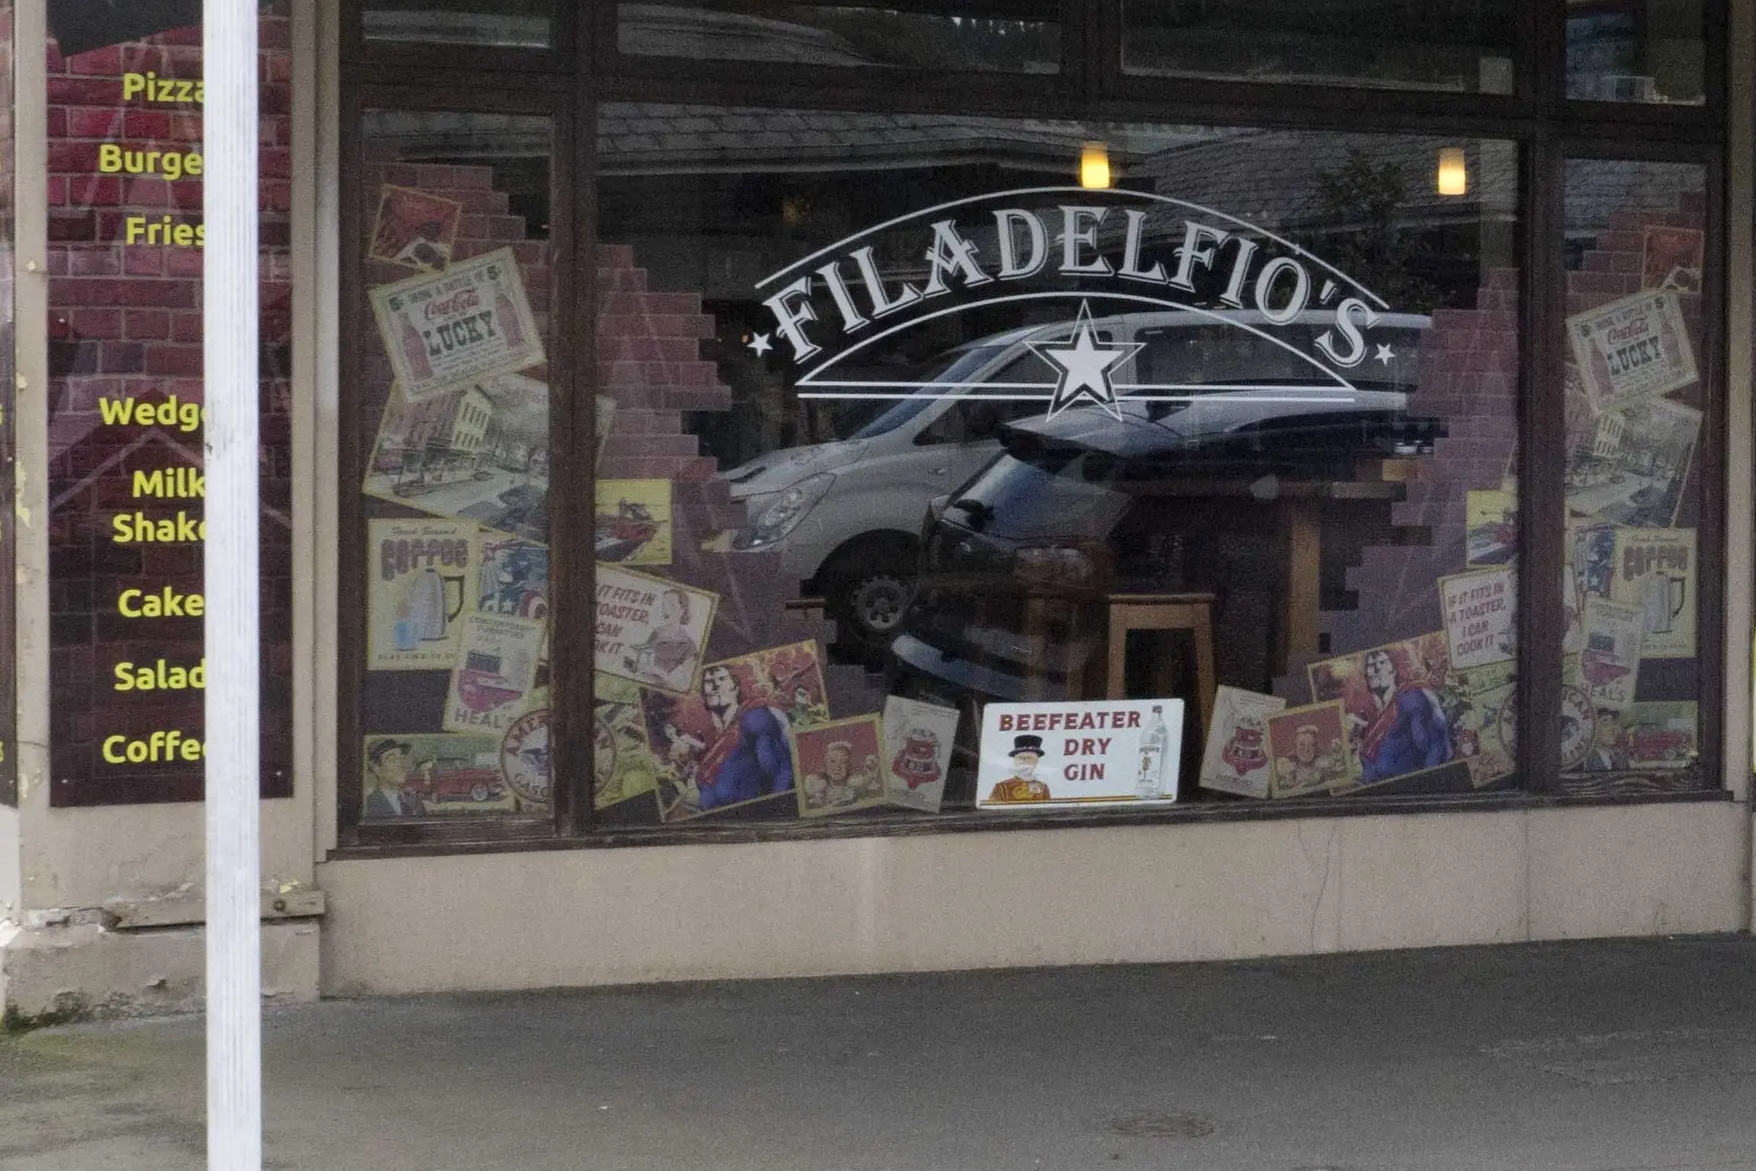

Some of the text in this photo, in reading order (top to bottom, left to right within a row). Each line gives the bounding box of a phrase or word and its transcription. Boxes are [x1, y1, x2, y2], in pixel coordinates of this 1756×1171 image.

[99, 144, 204, 181] Burge
[762, 204, 1382, 368] FILADELFIO'S
[422, 310, 496, 357] LUCKY
[1606, 335, 1661, 376] LUCKY
[99, 395, 206, 432] Wedg
[112, 511, 206, 543] Shak
[118, 586, 204, 617] Cake
[114, 659, 206, 691] Salad
[999, 710, 1141, 731] BEEFEATER
[102, 731, 206, 763] Coffe
[1063, 737, 1113, 756] DRY
[1063, 763, 1106, 781] GIN
